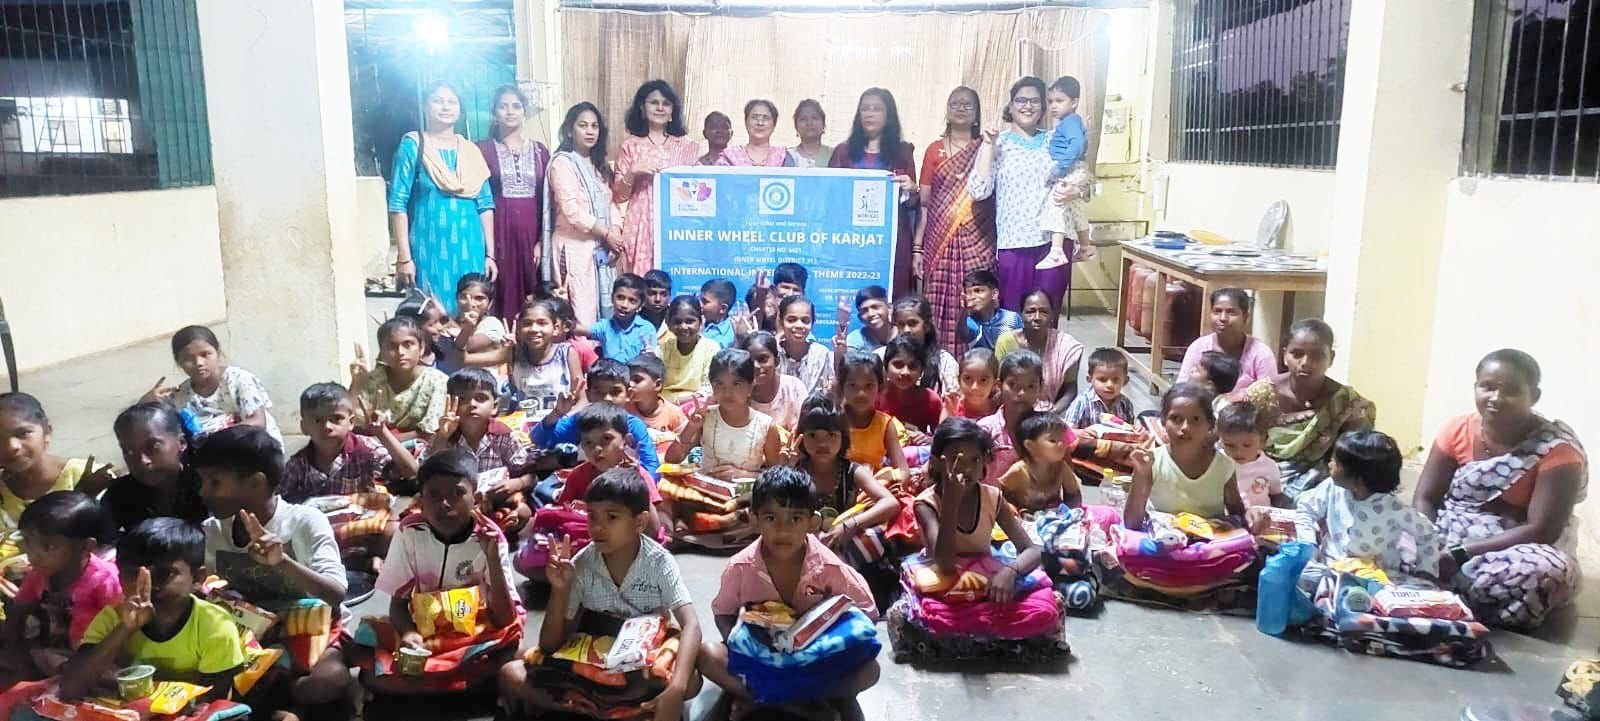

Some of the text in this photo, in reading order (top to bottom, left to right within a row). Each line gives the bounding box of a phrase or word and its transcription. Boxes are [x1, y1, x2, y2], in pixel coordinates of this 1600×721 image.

[668, 229, 885, 248] INNER WHEEL CLUB OF KARJAT
[670, 267, 745, 276] INTERNATIONAL
[813, 270, 844, 279] THEME
[846, 271, 881, 280] 2022-23
